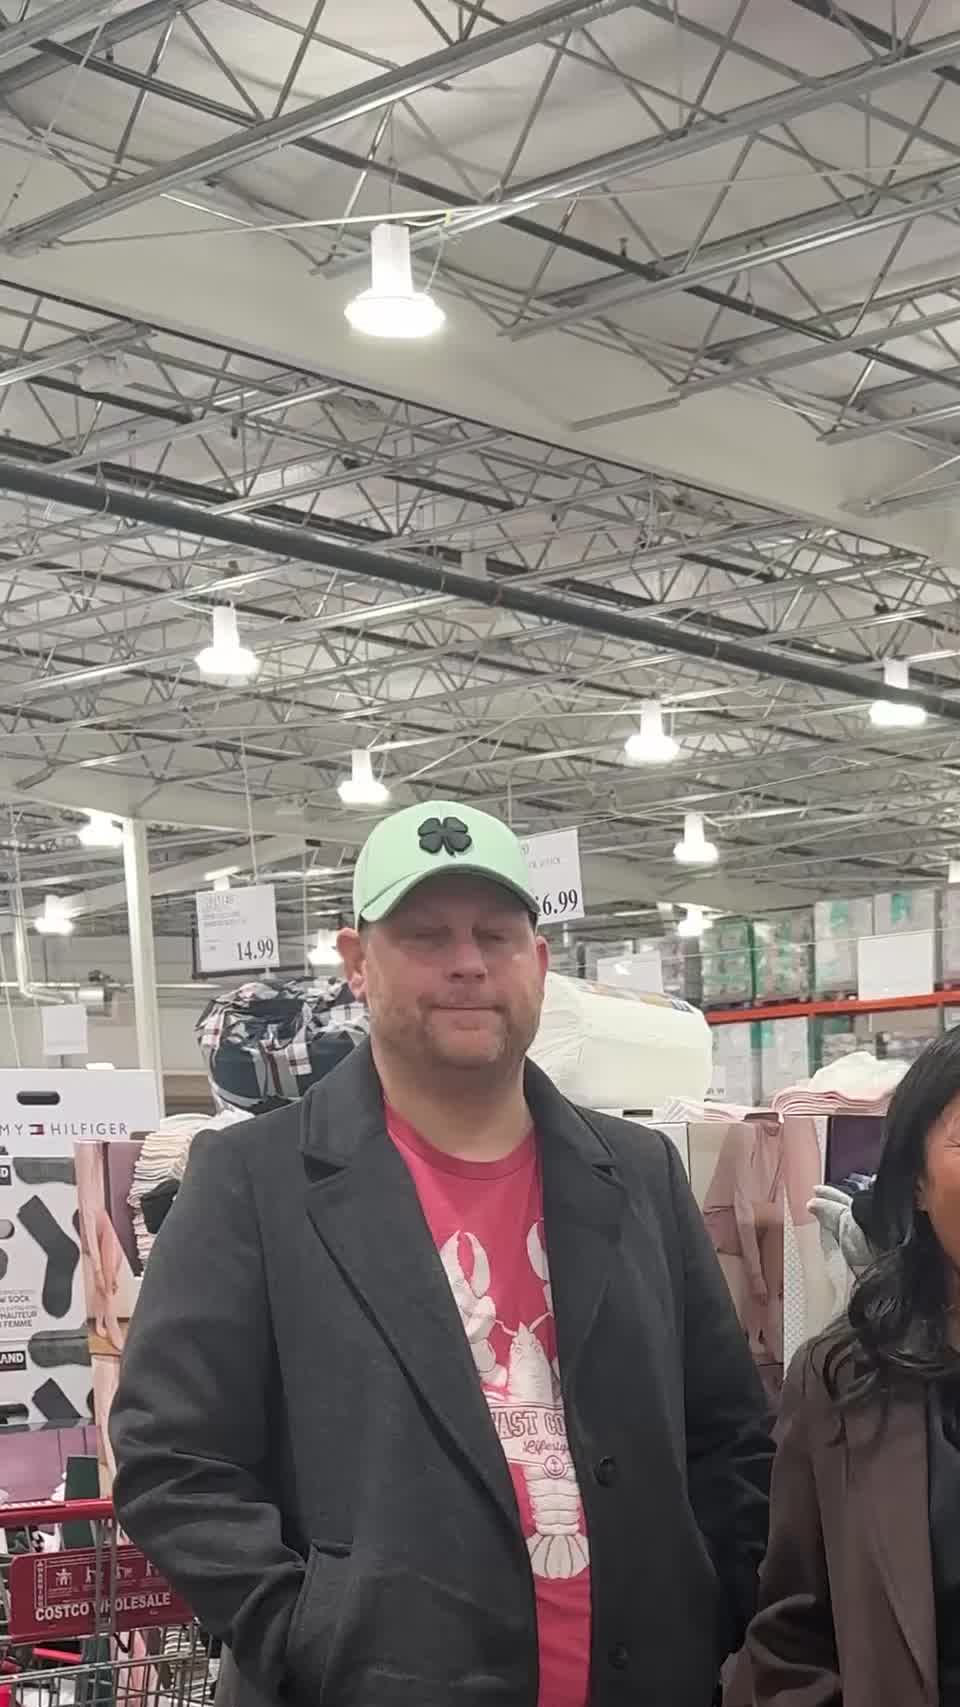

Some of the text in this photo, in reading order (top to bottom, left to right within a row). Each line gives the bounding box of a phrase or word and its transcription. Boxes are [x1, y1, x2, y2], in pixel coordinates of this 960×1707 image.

[535, 888, 578, 916] 6.99
[236, 938, 275, 961] 14.99
[50, 1122, 129, 1136] HILFIGER
[491, 1411, 538, 1440] AST
[35, 1602, 90, 1622] COSTCO
